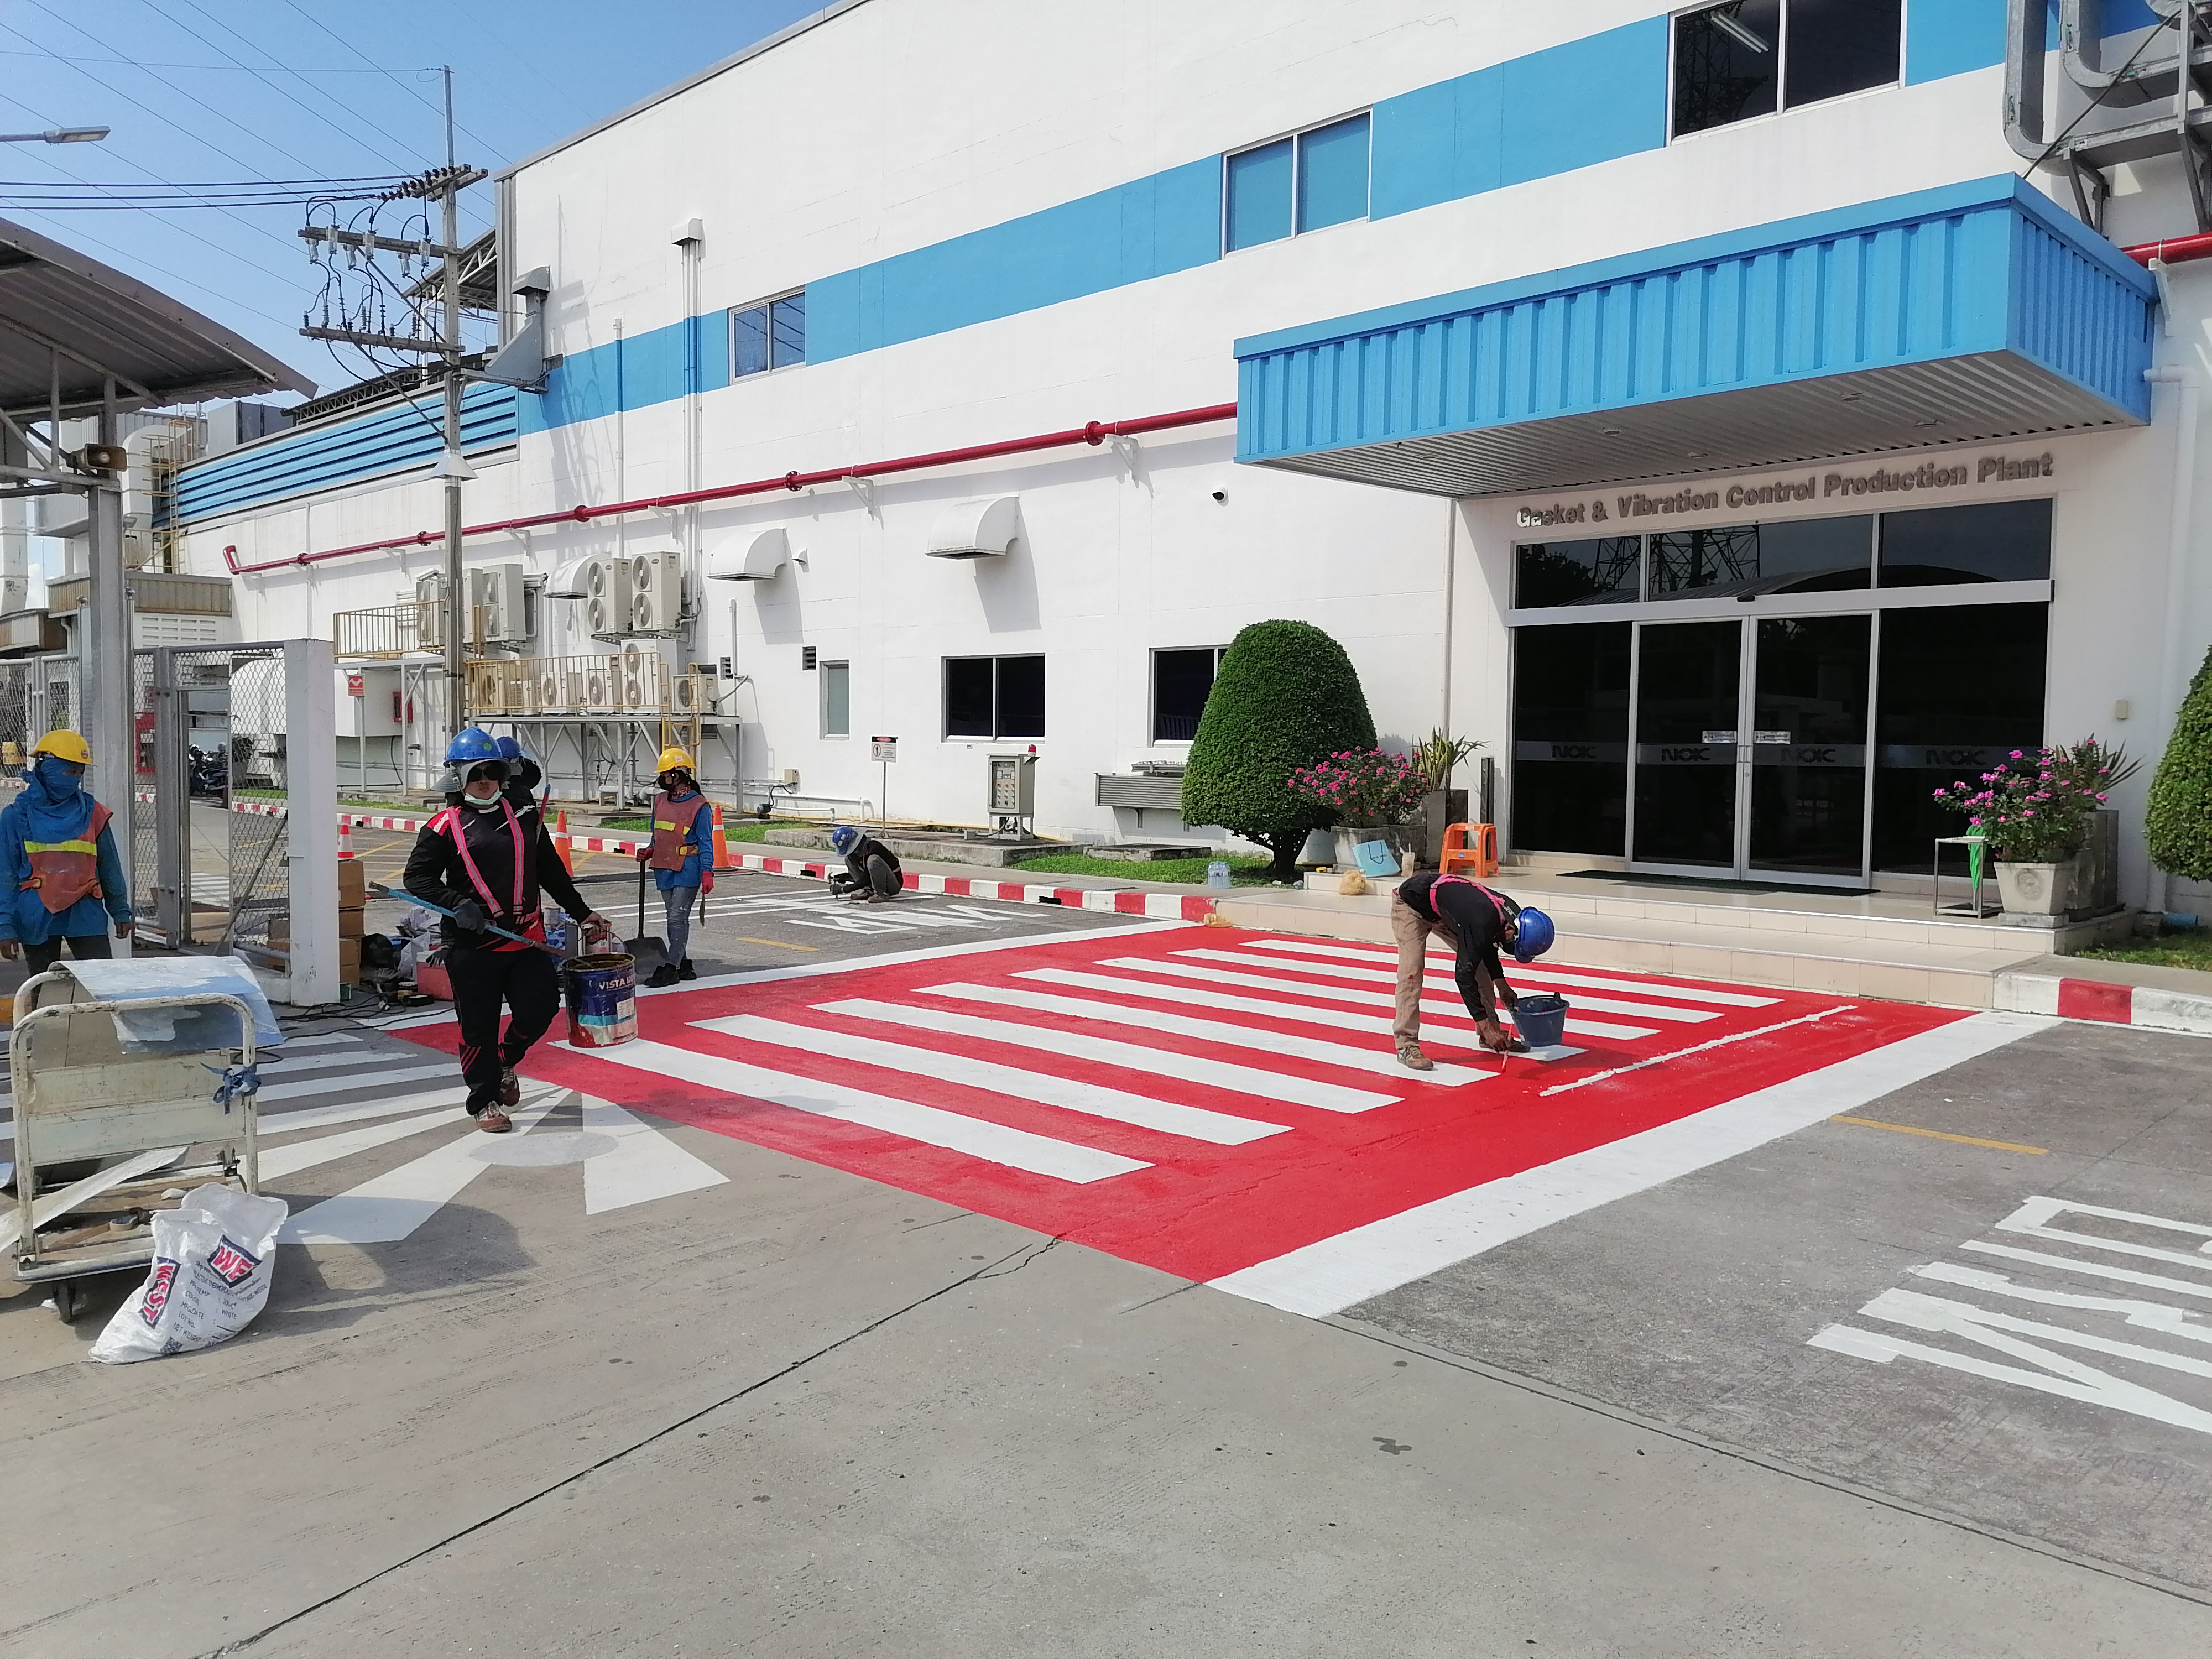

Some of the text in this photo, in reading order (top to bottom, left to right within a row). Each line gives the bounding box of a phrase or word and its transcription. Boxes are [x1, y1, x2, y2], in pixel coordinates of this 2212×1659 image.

[1516, 453, 2053, 528] Gasket & Vibration Control Production Plant
[599, 978, 625, 990] VISTA
[222, 1308, 237, 1320] WHITE
